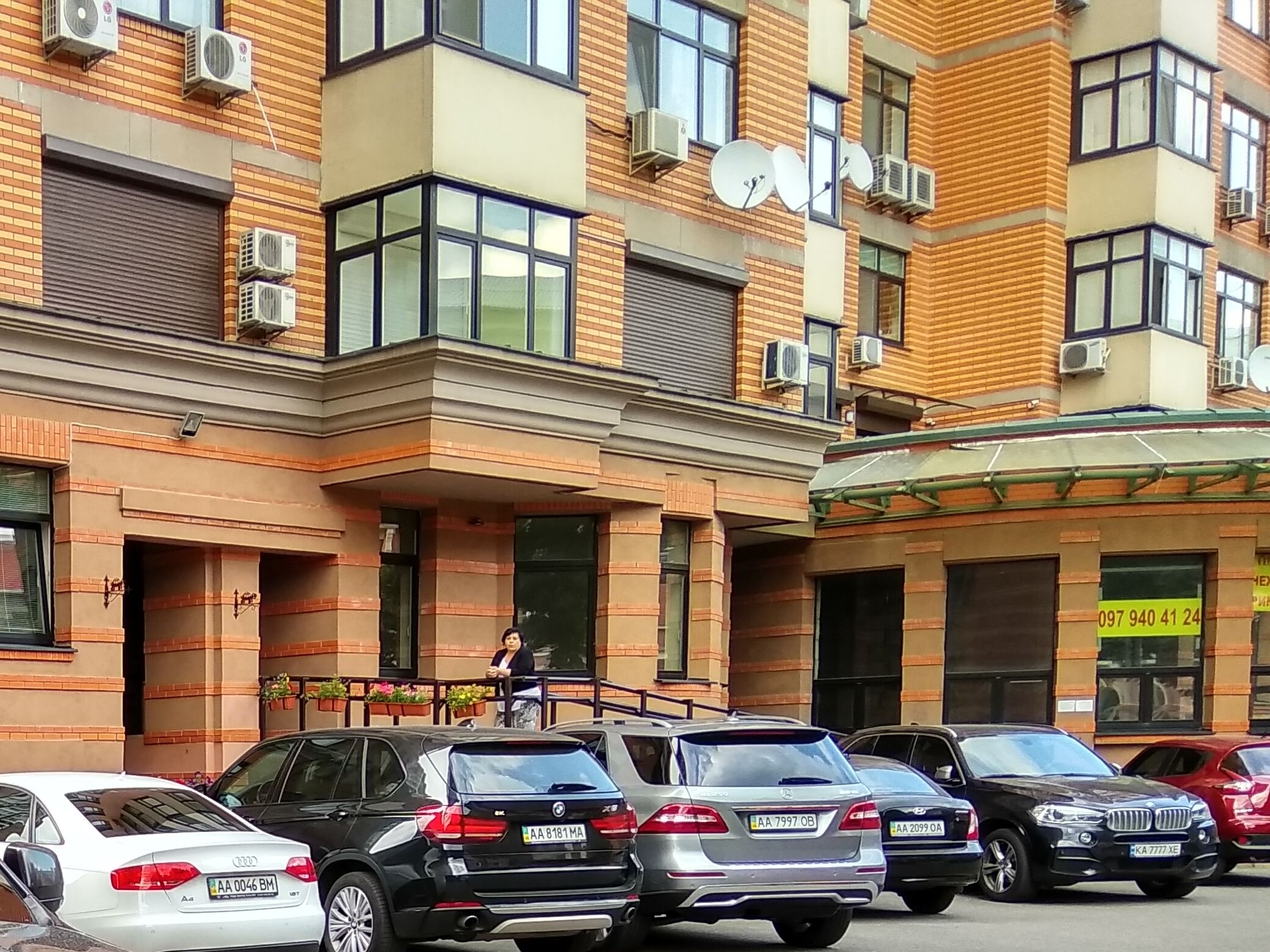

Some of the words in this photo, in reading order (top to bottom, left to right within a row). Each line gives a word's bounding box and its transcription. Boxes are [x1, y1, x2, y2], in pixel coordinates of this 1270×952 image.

[103, 15, 112, 23] LG
[1098, 610, 1125, 628] 097
[1129, 609, 1156, 627] 940
[1160, 608, 1177, 626] 41
[1183, 607, 1201, 626] 24
[758, 817, 772, 828] AA
[775, 816, 797, 828] 7997
[800, 815, 815, 827] OB
[896, 823, 908, 833] AA
[910, 823, 929, 833] 2099
[930, 823, 942, 832] OA
[530, 828, 545, 840] AA
[546, 827, 568, 839] 8181
[569, 826, 584, 838] MA
[1135, 846, 1147, 855] KA
[1149, 845, 1167, 855] 7777
[217, 880, 233, 893] AA
[234, 878, 258, 892] 0046
[259, 877, 275, 891] BM
